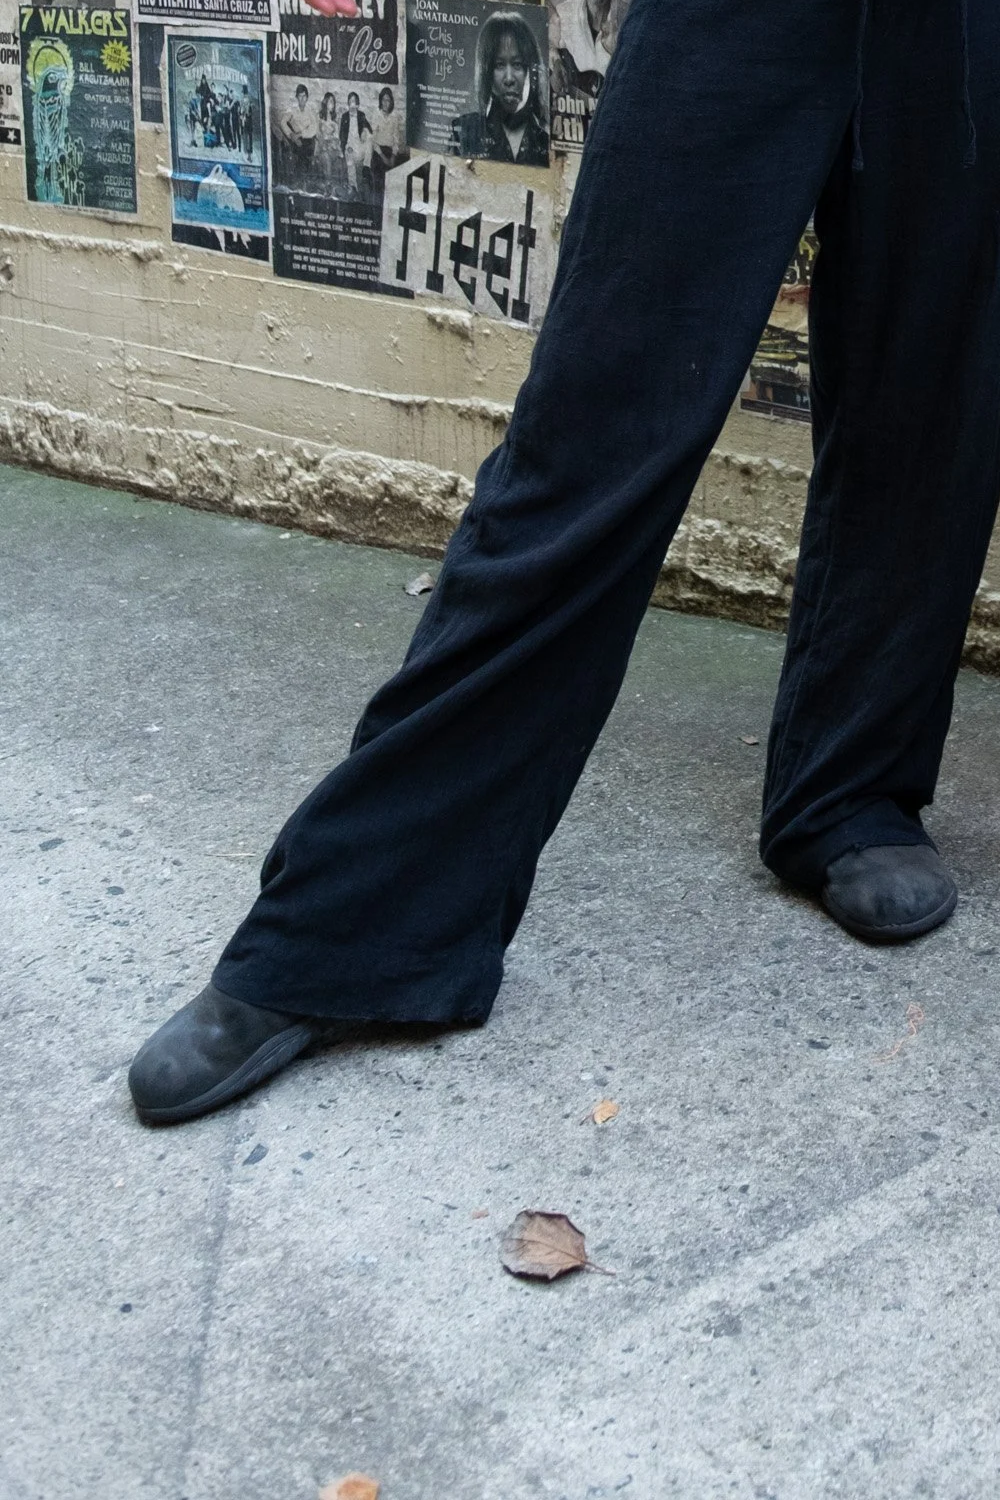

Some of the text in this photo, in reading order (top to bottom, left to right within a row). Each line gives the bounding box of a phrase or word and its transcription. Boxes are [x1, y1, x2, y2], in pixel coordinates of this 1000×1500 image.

[203, 0, 270, 14] SANTA CRUZ, CA
[416, 0, 439, 11] JOAN
[21, 8, 128, 38] 7 WALKERS
[412, 10, 479, 26] ARMATRADING
[428, 26, 452, 44] This
[274, 34, 309, 62] APRIL
[315, 35, 332, 63] 23
[78, 62, 94, 73] BILL
[435, 60, 452, 82] Life
